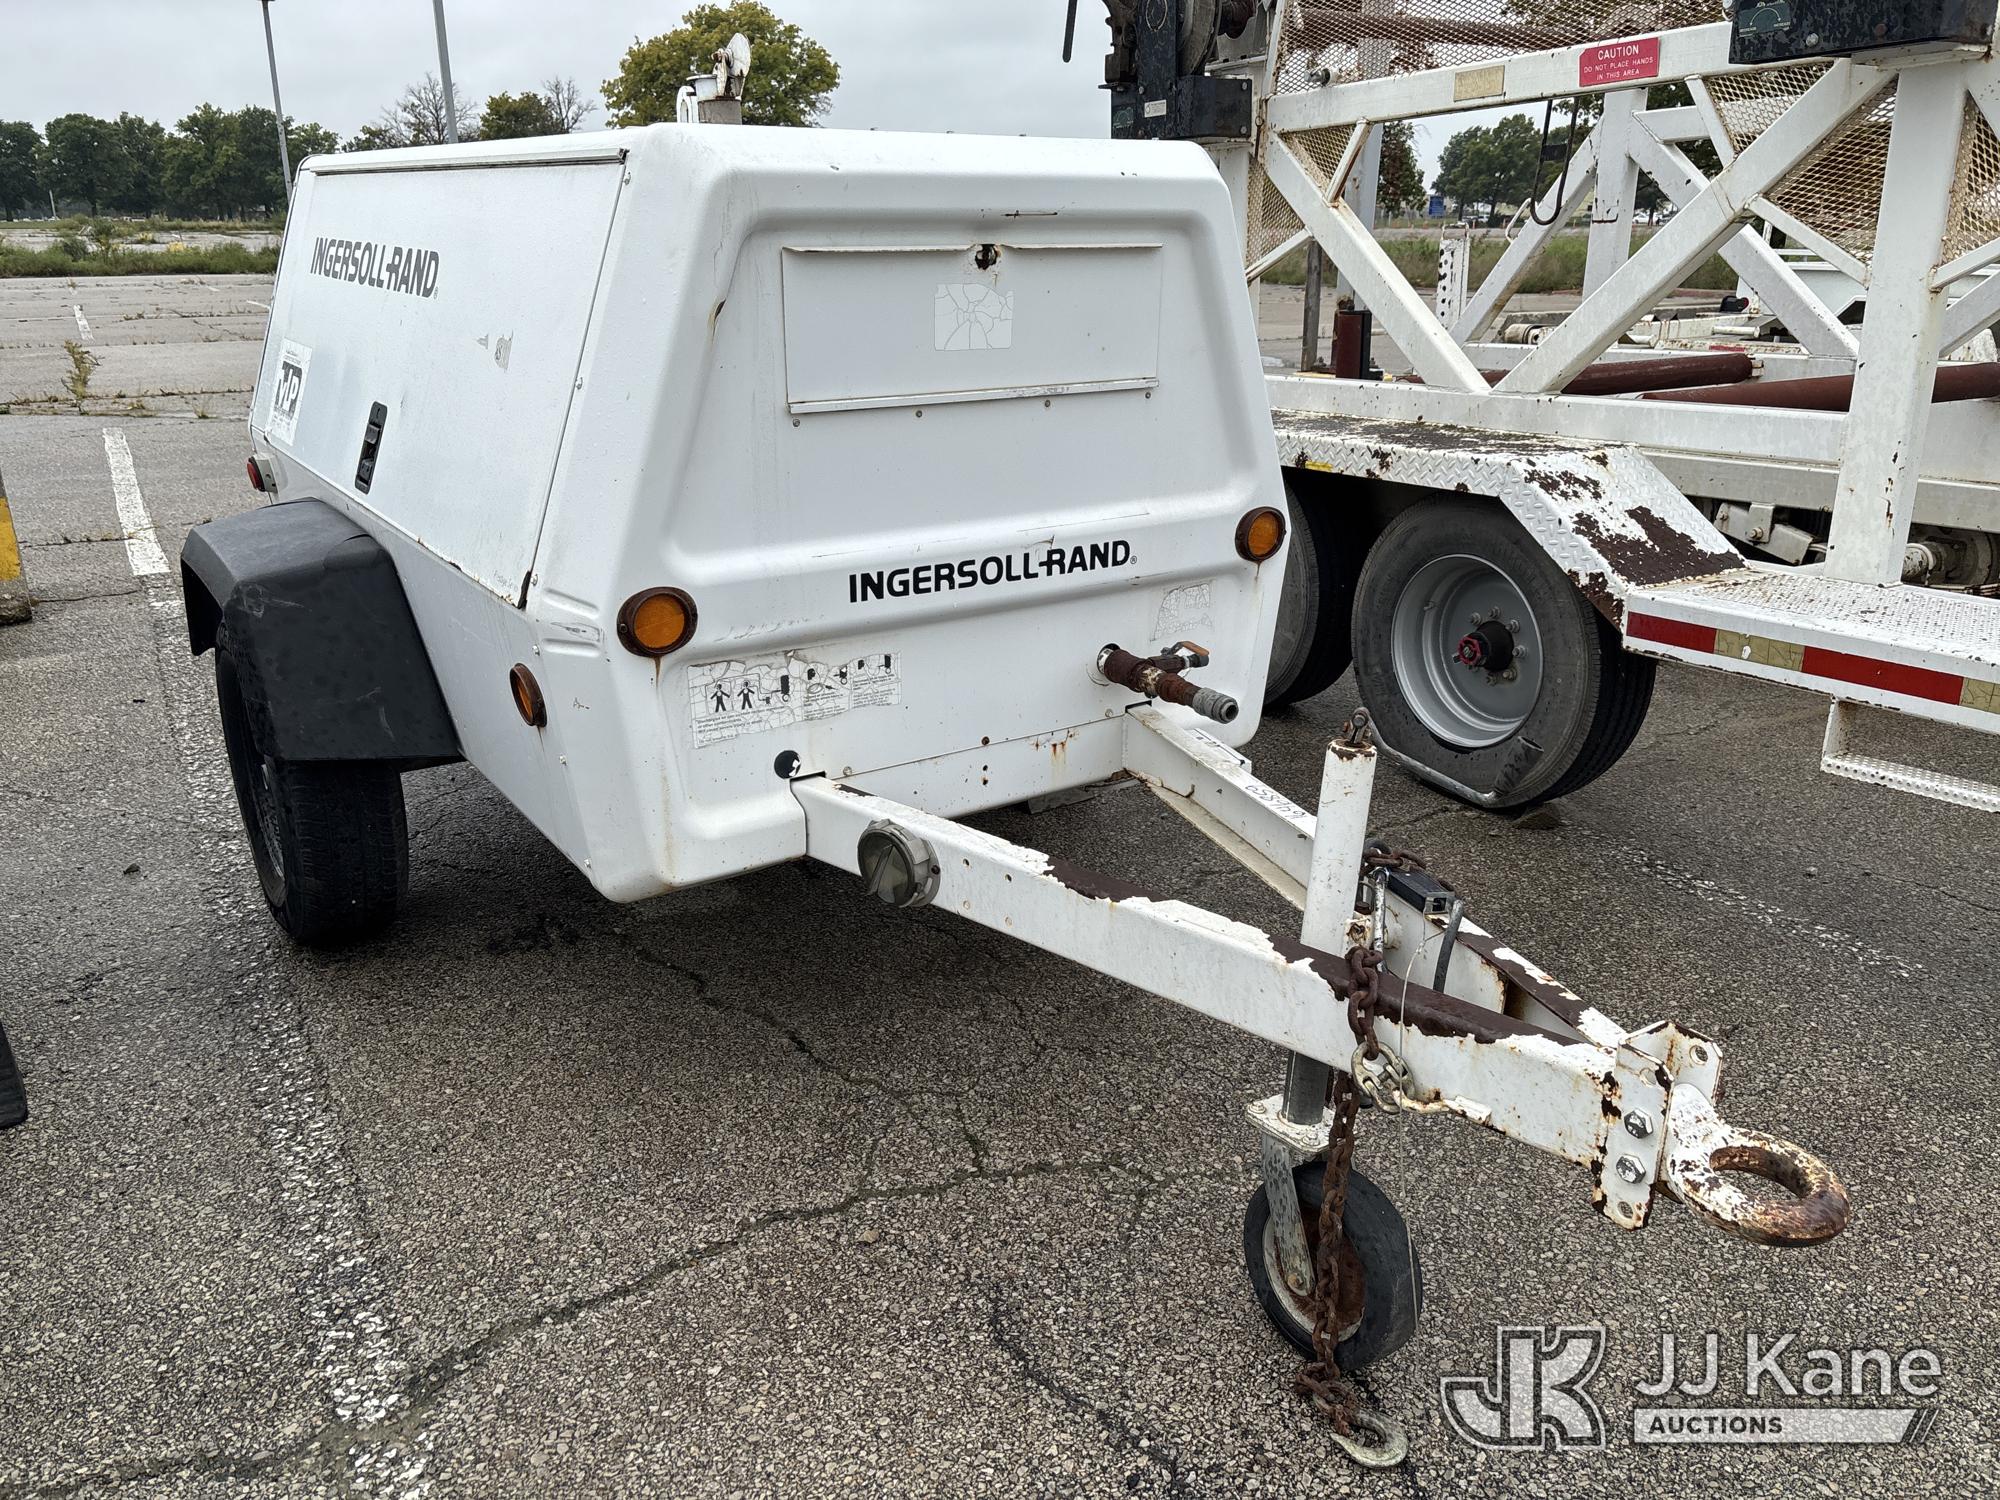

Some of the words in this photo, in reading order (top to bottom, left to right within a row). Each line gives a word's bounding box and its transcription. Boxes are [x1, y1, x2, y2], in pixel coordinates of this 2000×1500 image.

[1597, 44, 1639, 60] CAUTION
[1595, 63, 1607, 71] NOT
[1632, 56, 1654, 65] HANDS
